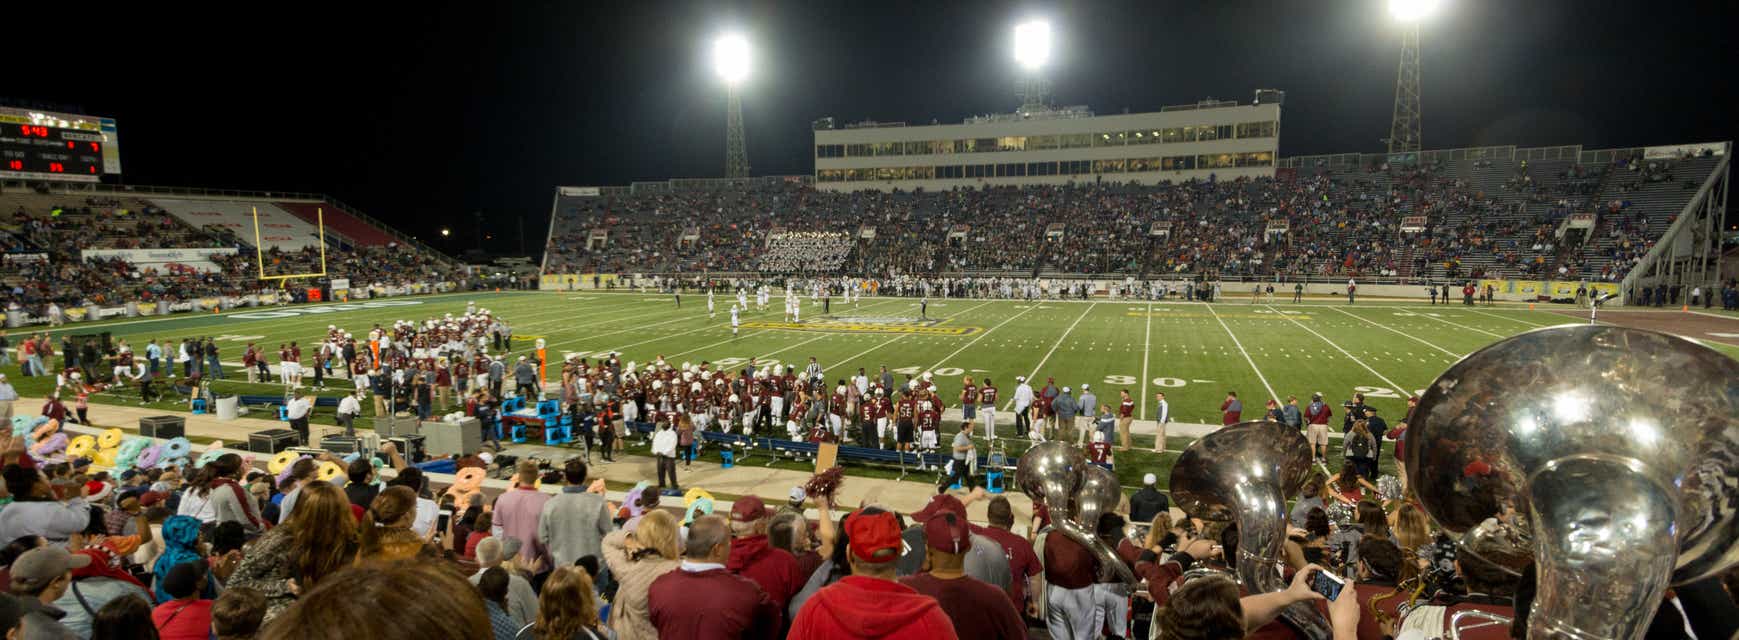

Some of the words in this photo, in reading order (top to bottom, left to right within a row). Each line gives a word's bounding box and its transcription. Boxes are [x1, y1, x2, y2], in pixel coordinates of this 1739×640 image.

[1103, 375, 1187, 388] 30
[900, 406, 912, 418] 56
[1096, 448, 1104, 461] 7
